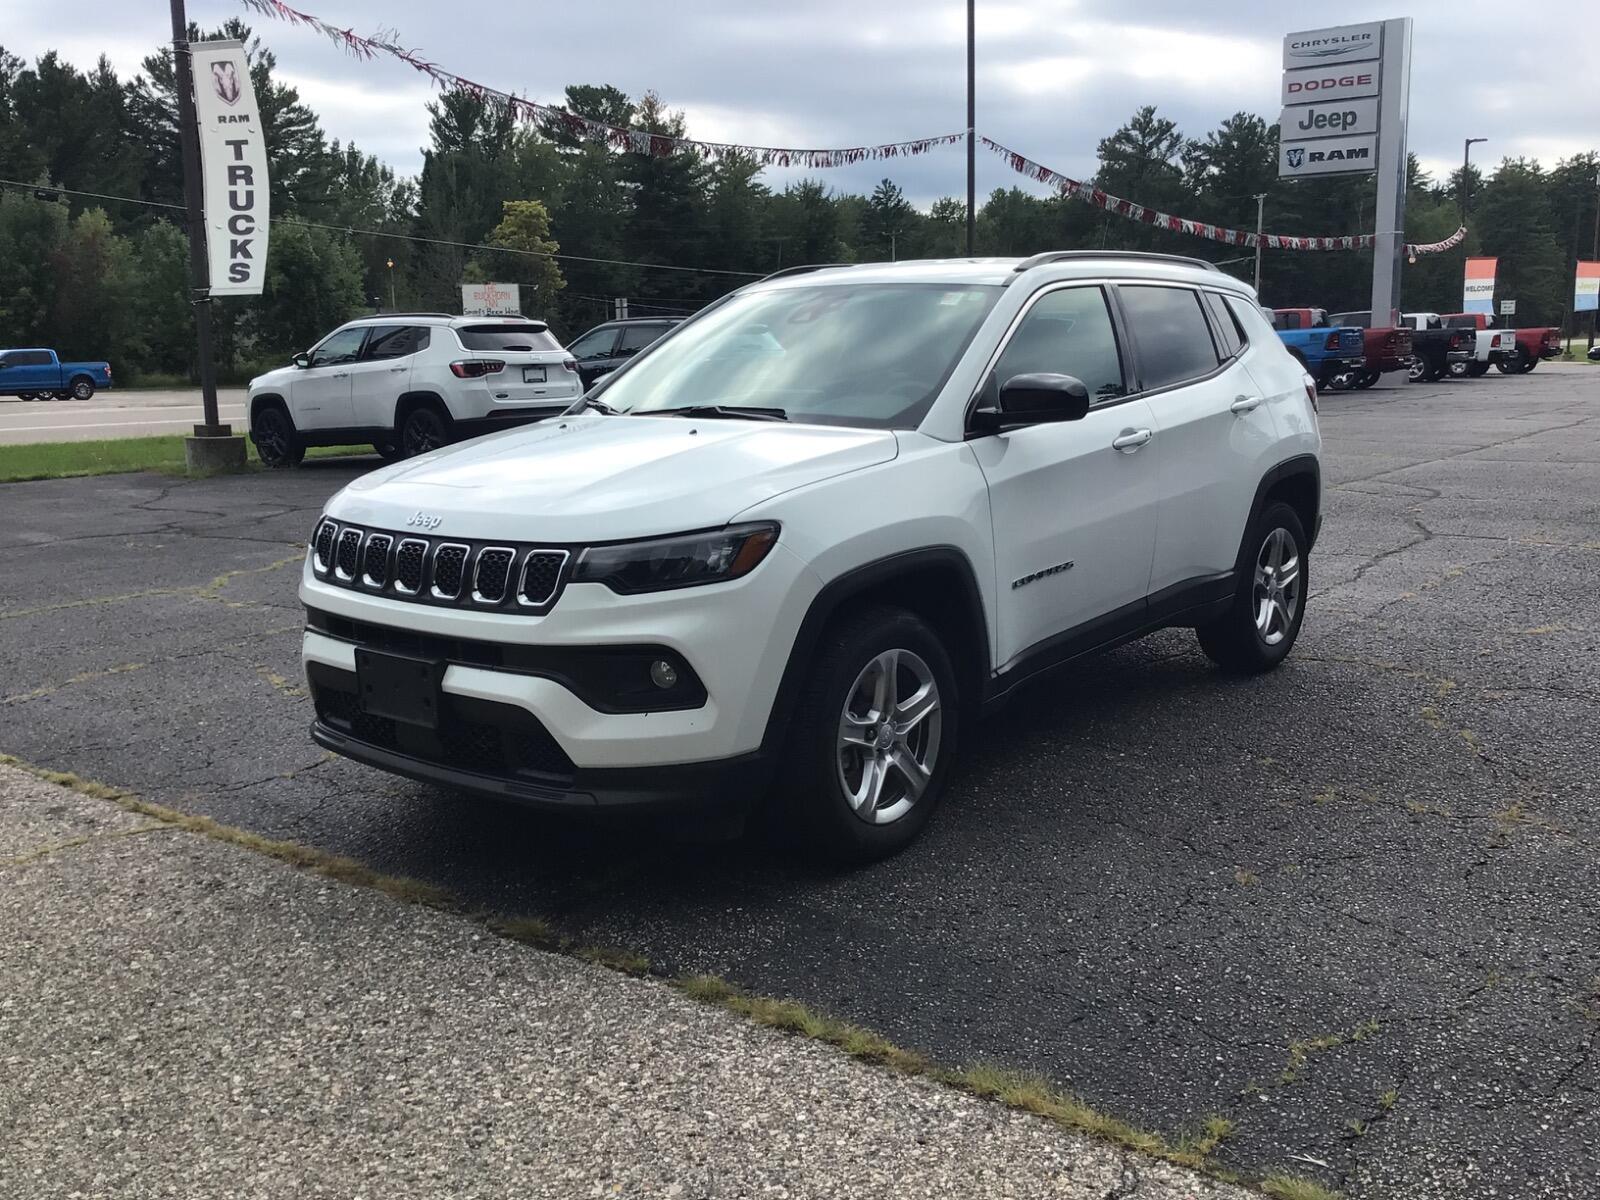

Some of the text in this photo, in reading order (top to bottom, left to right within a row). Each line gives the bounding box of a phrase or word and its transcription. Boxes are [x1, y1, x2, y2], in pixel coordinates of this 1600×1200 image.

[1291, 33, 1371, 49] CHRYSLER
[1288, 74, 1372, 93] DODGE
[217, 114, 250, 124] RAM
[1298, 109, 1357, 131] Jeep
[1309, 148, 1369, 162] RAM
[225, 139, 255, 283] TRUCKS
[406, 511, 442, 531] Jeep
